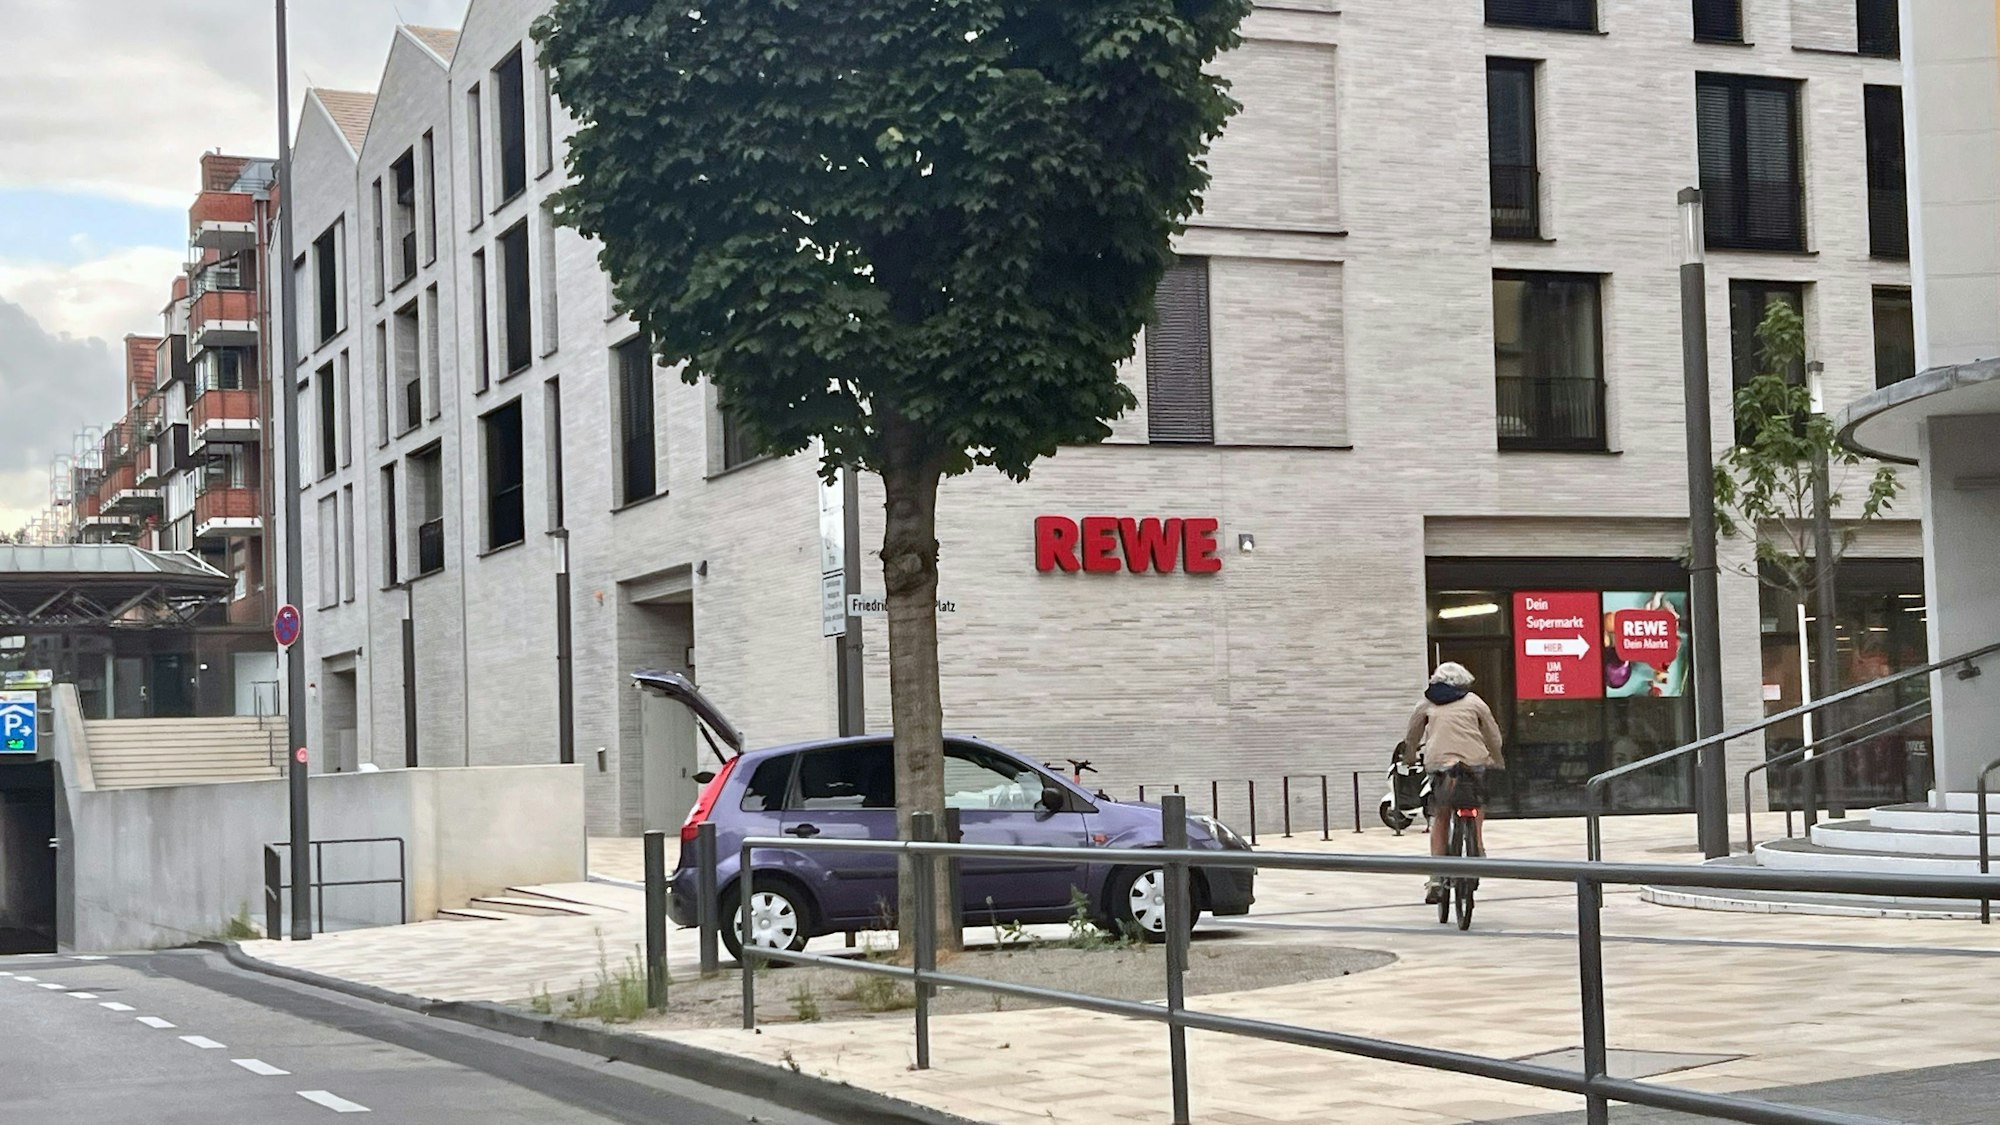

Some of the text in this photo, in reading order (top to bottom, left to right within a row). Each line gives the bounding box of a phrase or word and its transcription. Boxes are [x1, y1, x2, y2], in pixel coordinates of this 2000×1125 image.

[1034, 516, 1222, 573] REWE
[1525, 598, 1549, 611] Dein
[1526, 615, 1584, 631] Supermarkt
[1623, 621, 1668, 636] REWE
[1544, 643, 1563, 652] HIER
[1623, 639, 1669, 649] Dein Markt
[1546, 661, 1562, 671] UM
[1545, 673, 1560, 683] DIE
[1543, 684, 1565, 694] ECKE
[4, 713, 23, 737] P
